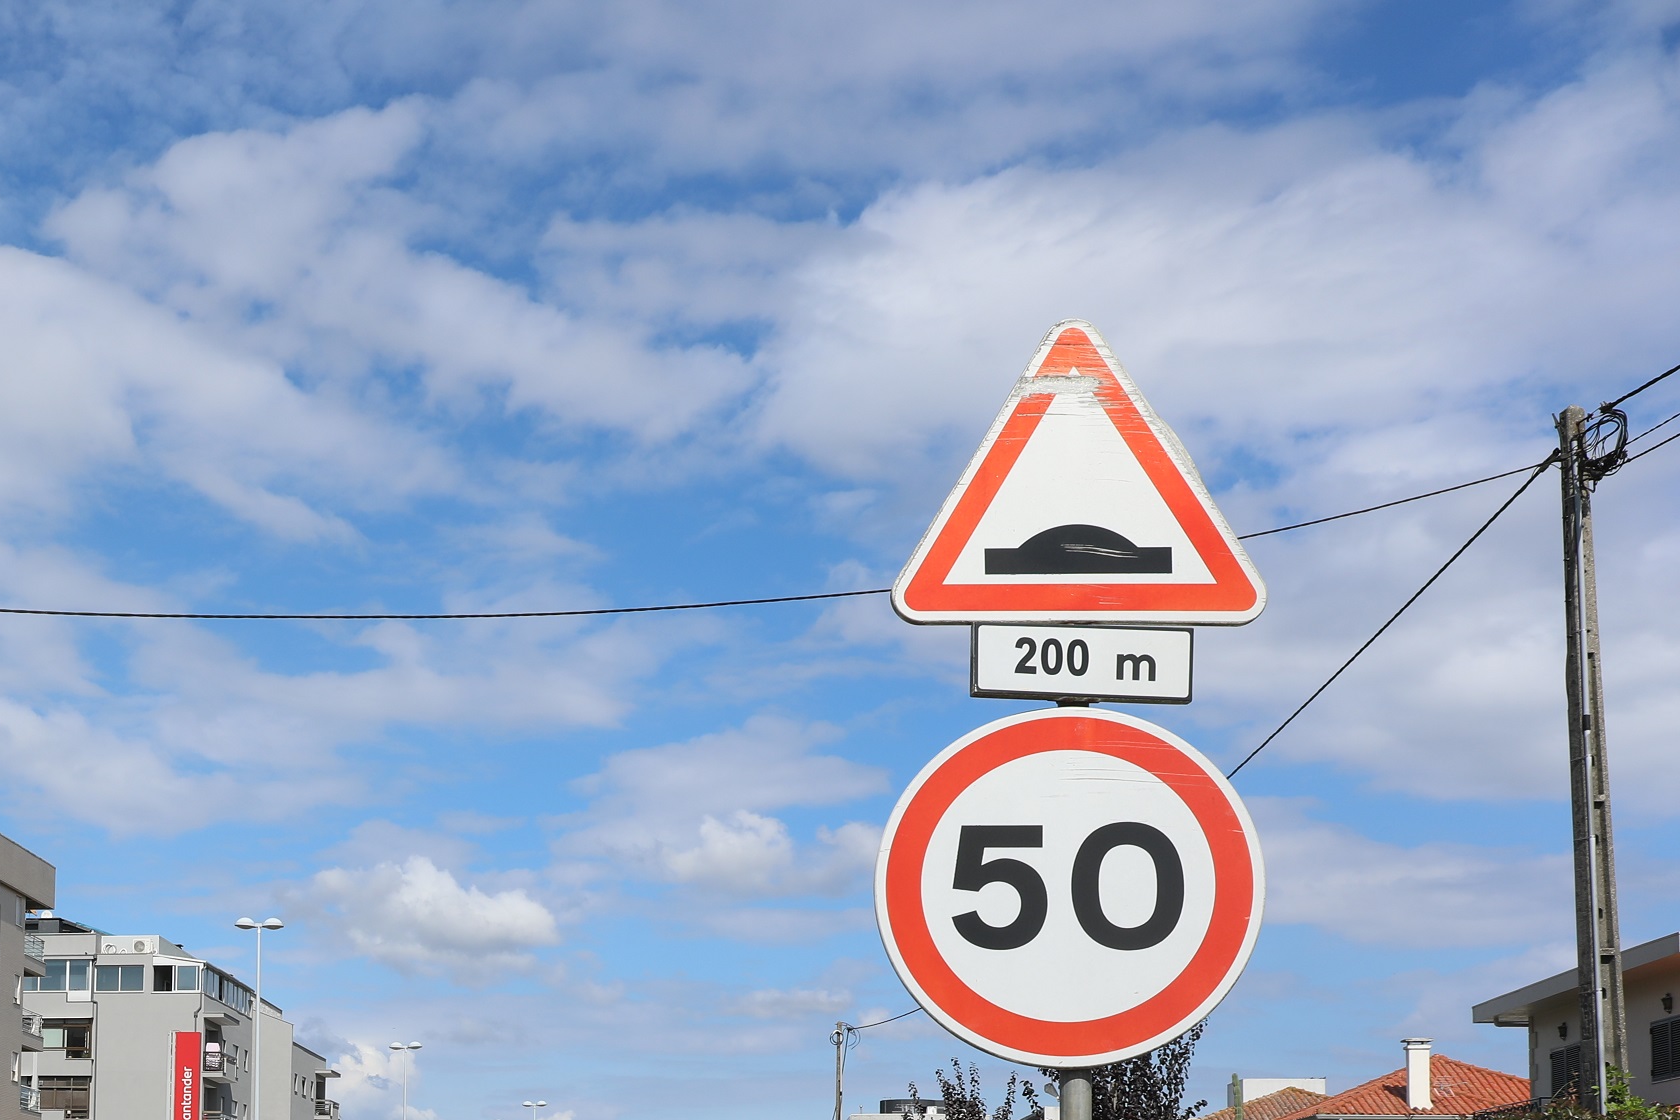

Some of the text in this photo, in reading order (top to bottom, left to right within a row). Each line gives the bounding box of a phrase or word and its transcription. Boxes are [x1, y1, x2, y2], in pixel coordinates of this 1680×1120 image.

[1014, 637, 1157, 682] 200 m
[951, 821, 1186, 951] 50
